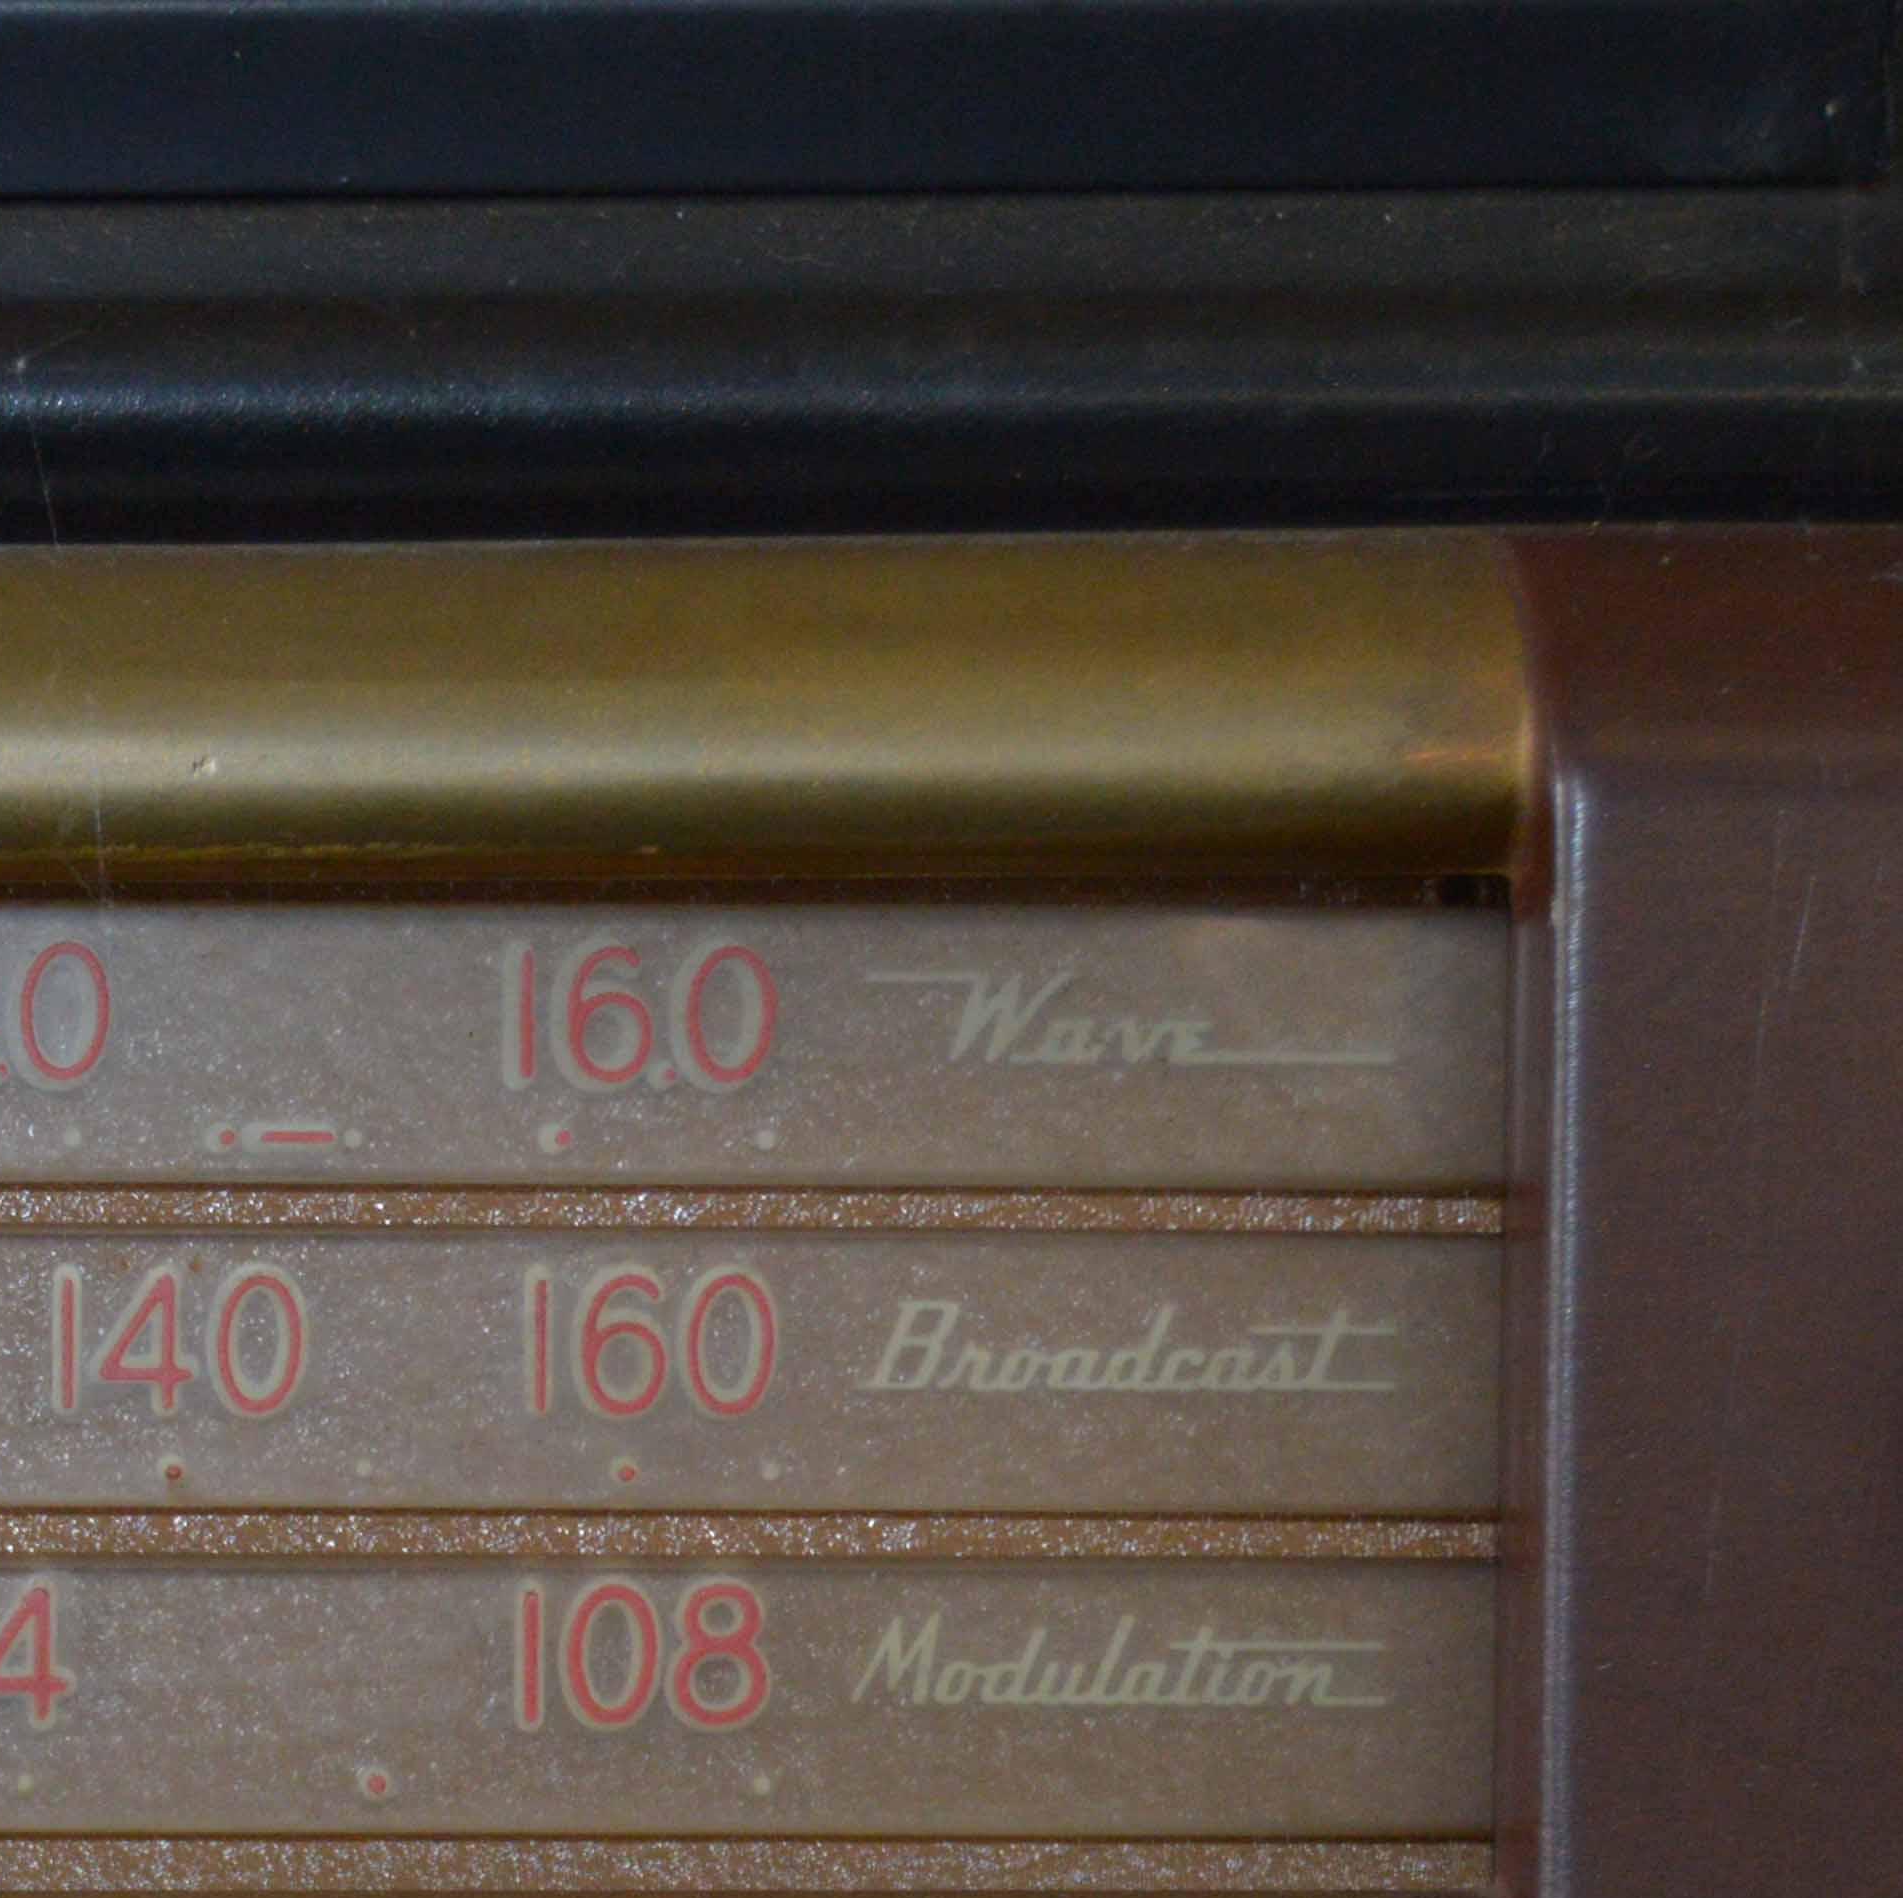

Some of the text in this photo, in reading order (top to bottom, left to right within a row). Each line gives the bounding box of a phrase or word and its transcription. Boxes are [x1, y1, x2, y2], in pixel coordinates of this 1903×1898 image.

[515, 941, 782, 1087] 16.0
[862, 966, 1394, 1067] Wave
[58, 1271, 306, 1418] 140
[530, 1270, 780, 1420] 160
[853, 1300, 1394, 1393] Broadcast
[519, 1580, 771, 1729] 108
[850, 1610, 1387, 1709] Modulation
